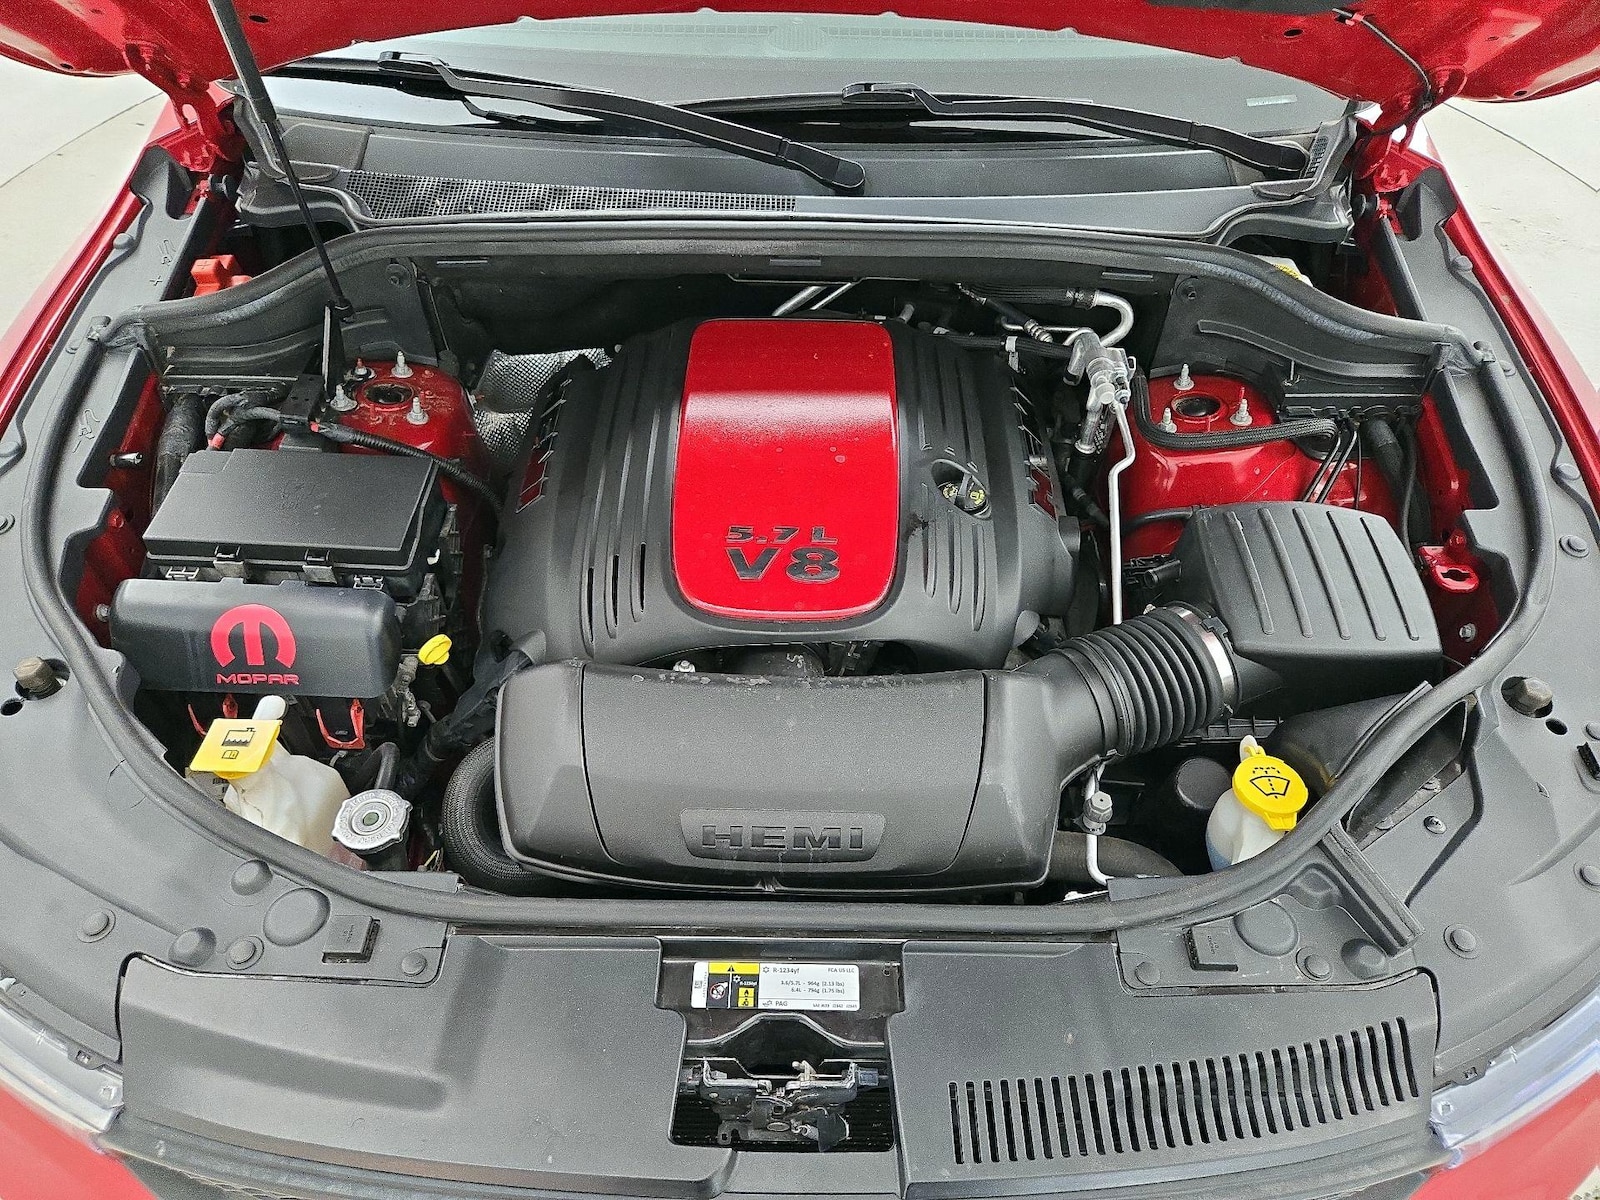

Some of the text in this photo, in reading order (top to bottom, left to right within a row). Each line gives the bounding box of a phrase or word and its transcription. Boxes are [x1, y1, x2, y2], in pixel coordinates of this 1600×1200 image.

[726, 525, 838, 544] 5.7 L
[725, 546, 840, 583] V8
[216, 673, 299, 685] MOPAR
[702, 825, 863, 850] HEMI
[835, 987, 845, 995] lbs)
